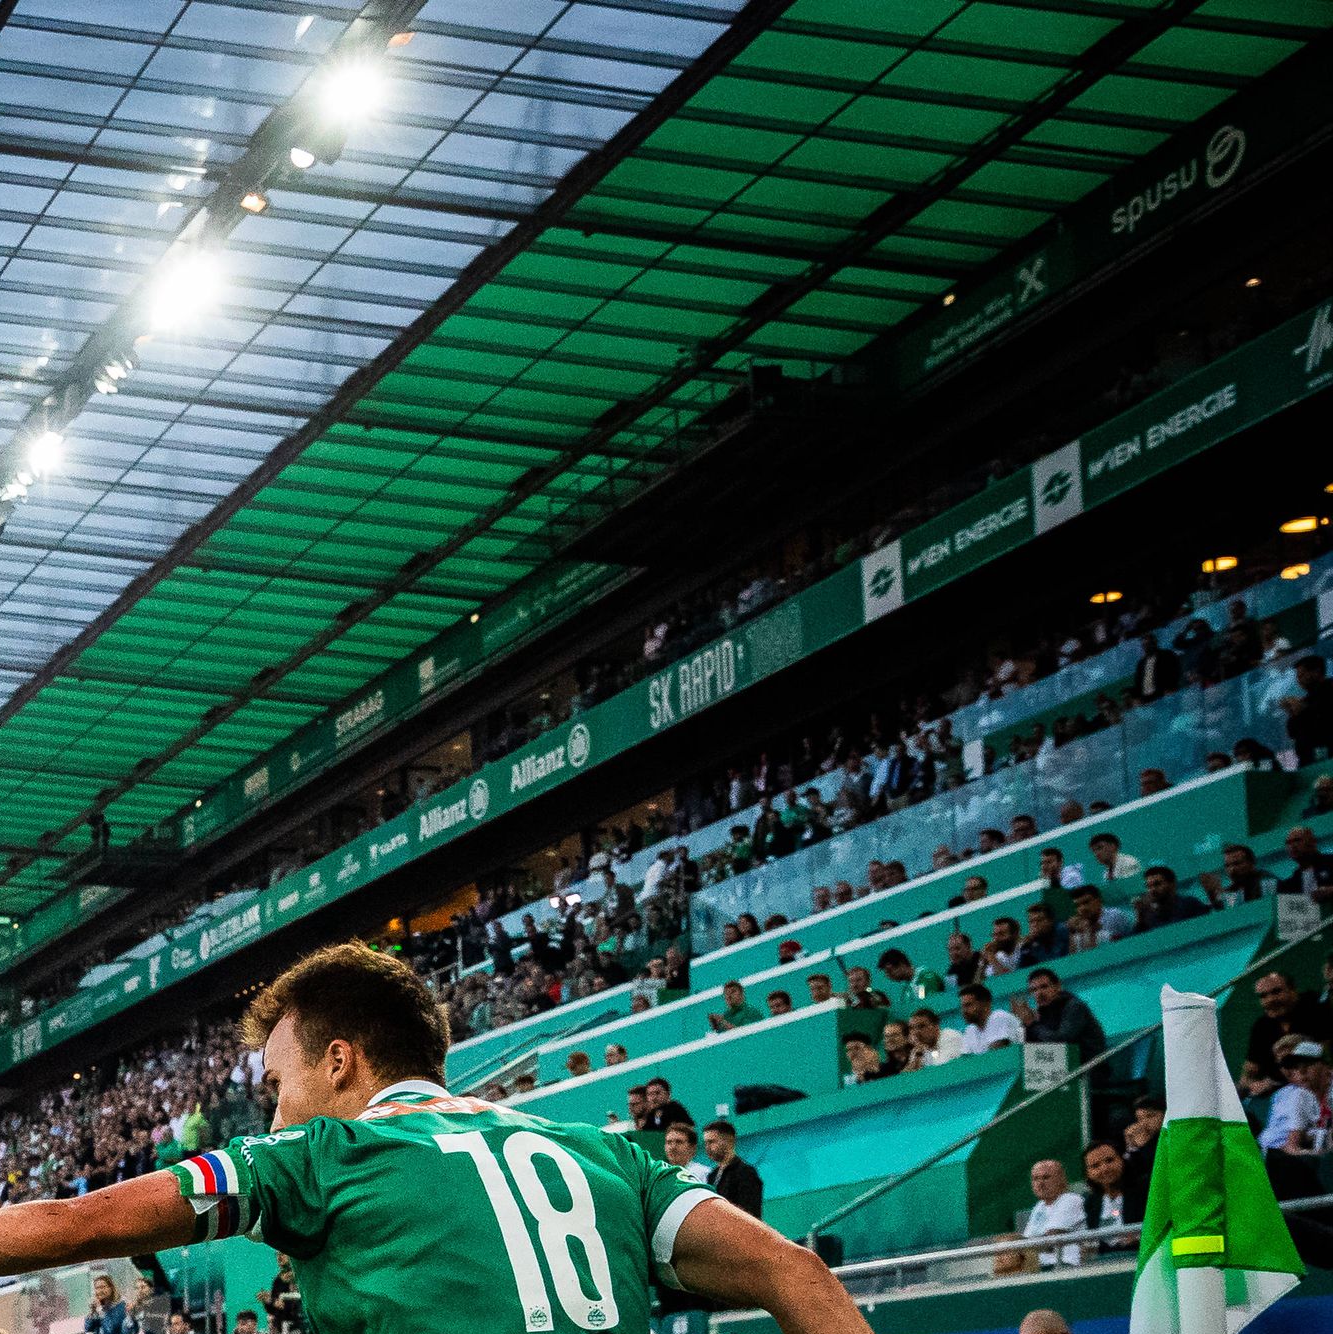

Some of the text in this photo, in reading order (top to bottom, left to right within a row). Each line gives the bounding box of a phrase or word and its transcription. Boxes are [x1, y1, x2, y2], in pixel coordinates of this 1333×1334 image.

[1111, 158, 1198, 234] spusu
[1087, 383, 1237, 480] WIEN ENERGIE
[907, 497, 1028, 576] WIEN ENERGIE
[649, 639, 735, 728] SK RAPID
[510, 745, 566, 793] Allianz
[419, 799, 468, 842] Allianz
[434, 1131, 620, 1333] 18
